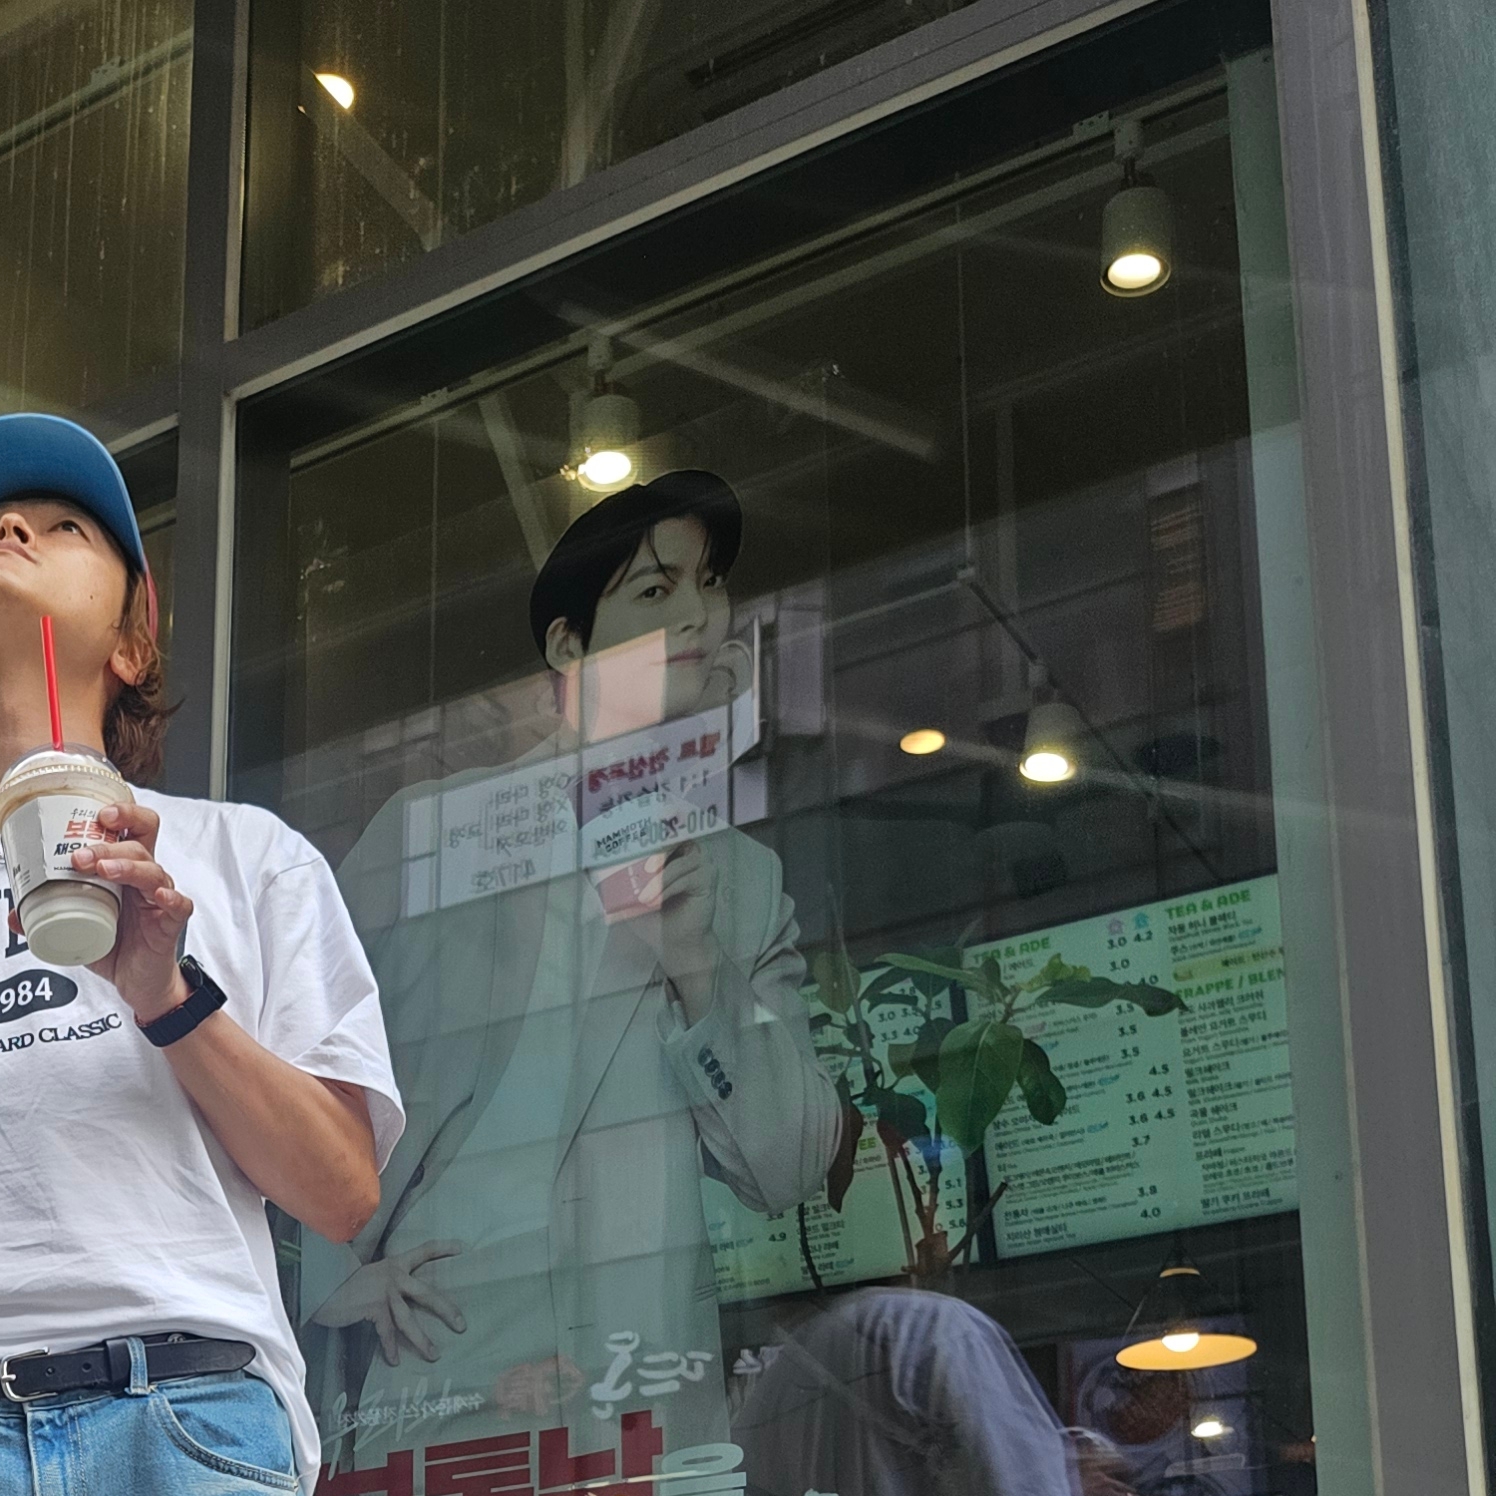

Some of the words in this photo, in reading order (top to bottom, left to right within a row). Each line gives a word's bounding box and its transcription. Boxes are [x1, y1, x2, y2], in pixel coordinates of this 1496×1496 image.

[70, 807, 97, 820] 우리의
[596, 816, 652, 850] MAMMOTH
[604, 828, 648, 854] COFFEE
[1165, 902, 1197, 920] TEA
[1217, 889, 1251, 908] ADE
[1019, 936, 1052, 956] ADE
[38, 1012, 123, 1044] CLASSIC
[1148, 1063, 1170, 1077] 4.5
[1151, 1085, 1173, 1099] 4.5
[1153, 1107, 1176, 1121] 4.5
[1131, 1133, 1151, 1148] 3.7
[1139, 1206, 1162, 1220] 4.0
